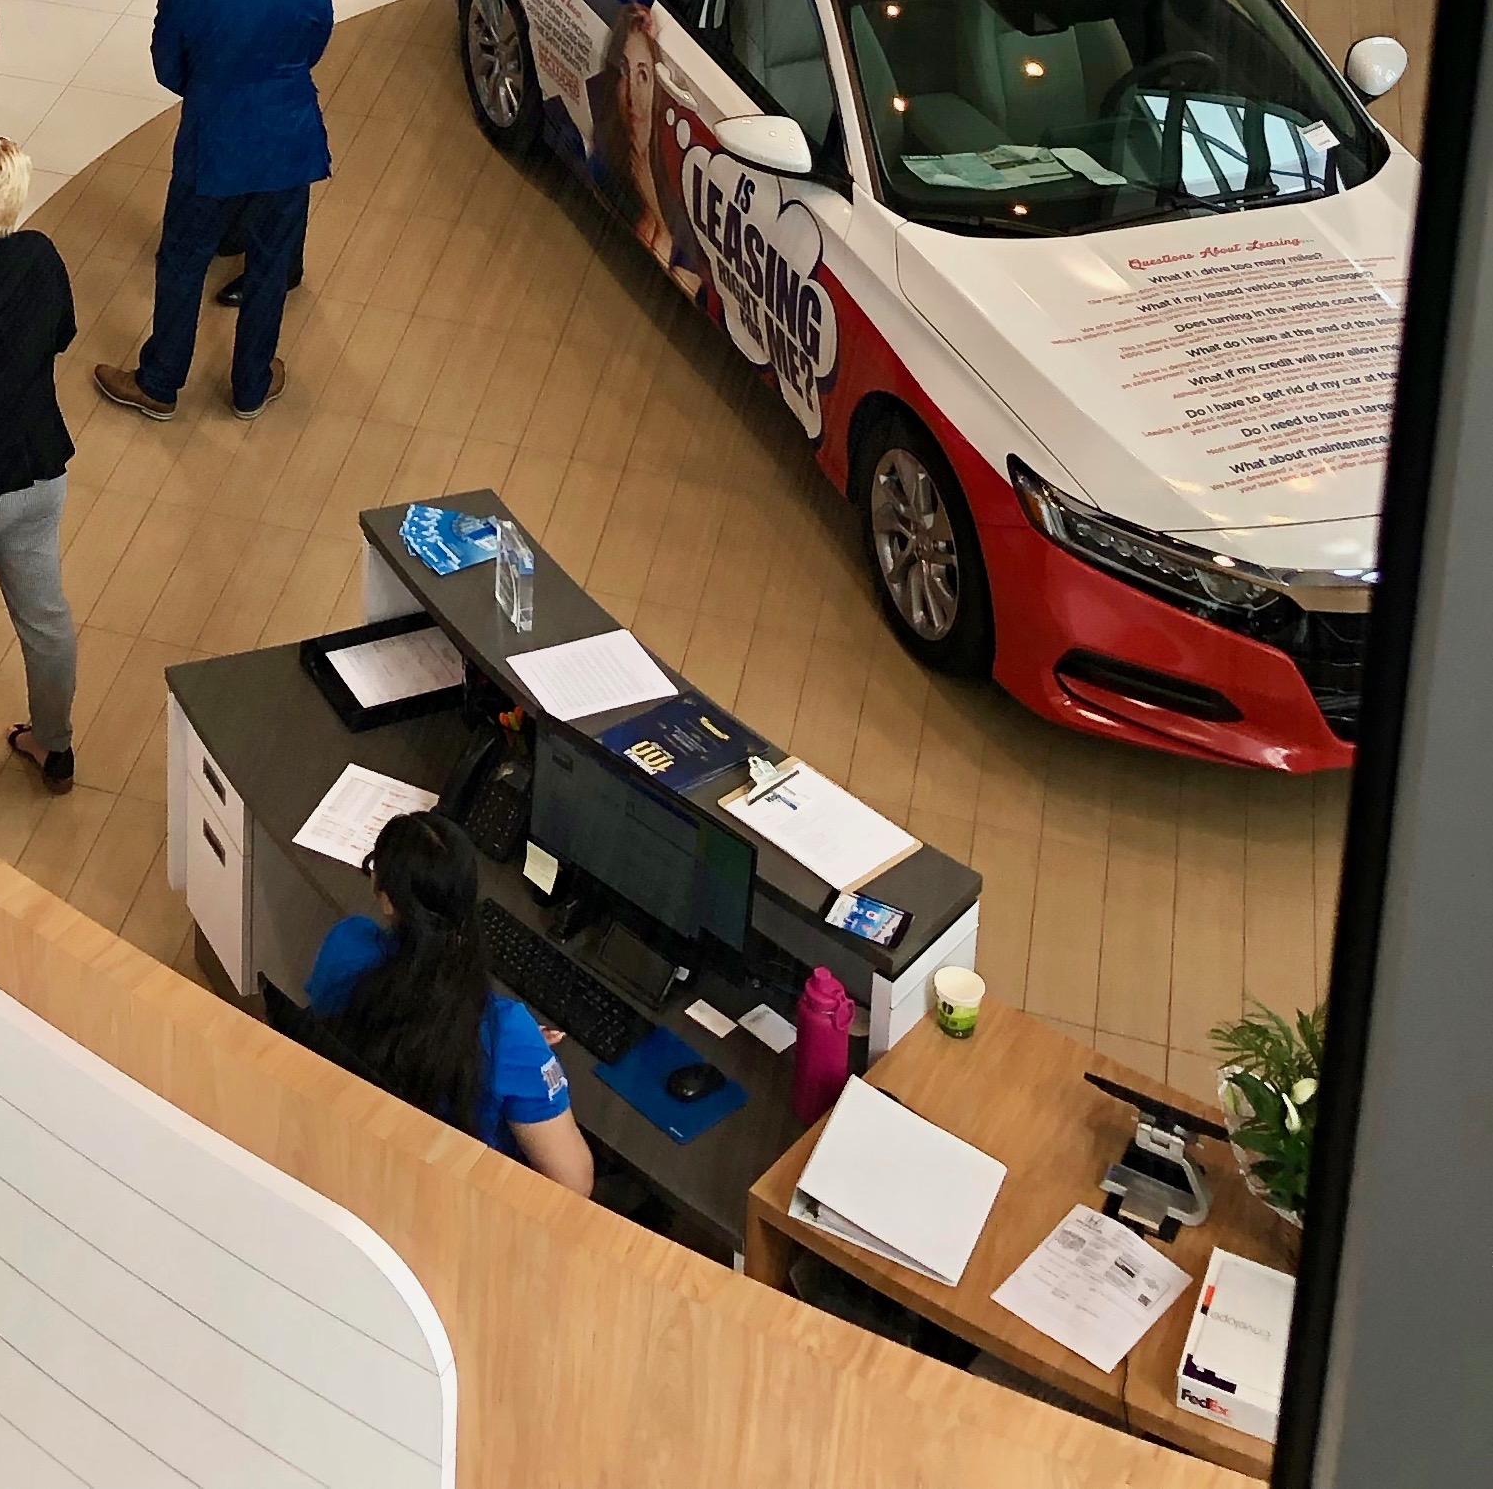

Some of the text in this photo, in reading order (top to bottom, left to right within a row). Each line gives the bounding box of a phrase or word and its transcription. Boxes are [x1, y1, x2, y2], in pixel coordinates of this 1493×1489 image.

[734, 172, 756, 214] IS
[693, 163, 822, 366] LEASING
[1128, 253, 1194, 270] Questions
[1200, 243, 1241, 259] About
[1148, 269, 1182, 285] What
[1183, 268, 1192, 278] if
[1200, 264, 1231, 276] drive
[1233, 260, 1253, 271] too
[1254, 256, 1286, 268] many
[716, 255, 759, 319] RIGHT
[1137, 299, 1171, 314] What
[1173, 296, 1182, 307] if
[1184, 294, 1203, 306] my
[1204, 287, 1244, 301] leased
[1245, 281, 1286, 295] vehicle
[1288, 277, 1314, 288] gets
[739, 306, 765, 353] FOR
[1173, 319, 1207, 333] Does
[1208, 310, 1252, 325] turning
[1253, 309, 1265, 318] in
[1267, 306, 1287, 316] the
[1289, 300, 1330, 312] vehicle
[1331, 296, 1357, 306] cost
[1186, 343, 1222, 358] What
[1223, 339, 1241, 349] do
[1247, 332, 1278, 344] have
[1279, 331, 1293, 340] at
[1293, 327, 1315, 337] the
[1316, 323, 1340, 334] end
[1341, 321, 1355, 330] of
[1354, 318, 1376, 329] the
[764, 310, 815, 413] ME?
[1188, 373, 1223, 387] What
[1225, 369, 1235, 379] if
[1236, 365, 1256, 376] my
[1257, 358, 1294, 371] credit
[1295, 354, 1318, 365] will
[1318, 351, 1345, 361] now
[1346, 346, 1379, 357] allow
[1185, 407, 1206, 419] Do
[1213, 399, 1245, 412] have
[1245, 394, 1261, 405] to
[1262, 388, 1285, 401] get
[1285, 384, 1305, 395] rid
[1305, 381, 1319, 392] of
[1320, 379, 1341, 390] my
[1342, 377, 1362, 386] car
[1363, 373, 1378, 383] at
[1376, 371, 1399, 381] the
[1240, 427, 1261, 438] Do
[1270, 416, 1303, 431] need
[1303, 414, 1319, 424] to
[1318, 409, 1350, 421] have
[1351, 406, 1360, 415] a
[1360, 402, 1395, 414] large
[1229, 458, 1267, 474] What
[1268, 449, 1308, 465] about
[1307, 434, 1389, 457] maintenance
[1181, 1387, 1230, 1417] FedEx
